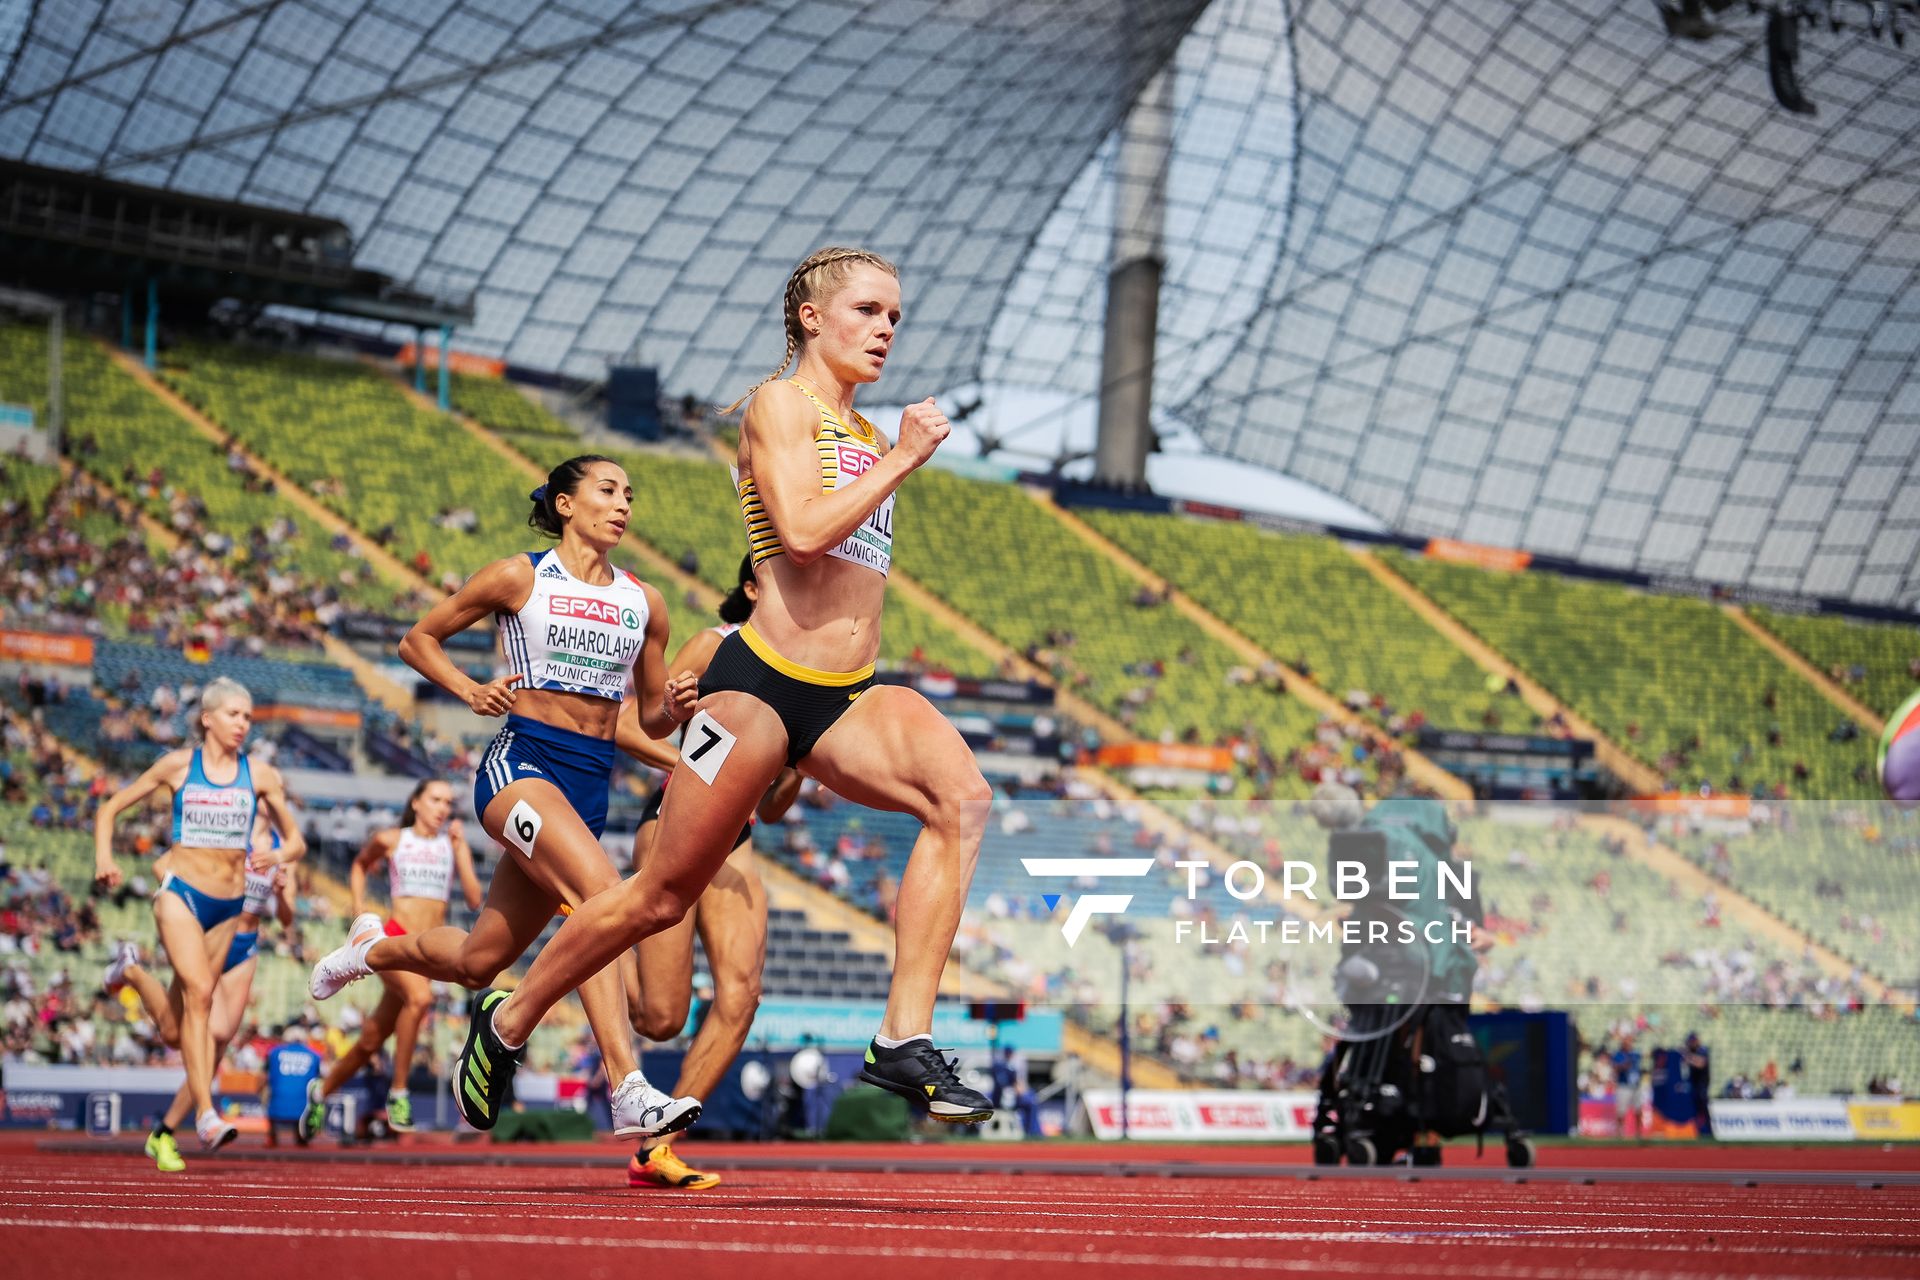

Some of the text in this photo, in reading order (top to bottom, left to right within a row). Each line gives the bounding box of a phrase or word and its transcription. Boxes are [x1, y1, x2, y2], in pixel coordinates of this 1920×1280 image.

[840, 449, 874, 475] SP
[870, 503, 892, 539] ILL
[839, 540, 878, 566] UNICH
[539, 572, 568, 582] adidas
[551, 597, 619, 624] SPAR
[546, 624, 640, 661] RAHAROLAHY
[545, 663, 622, 688] MUNICH 2022
[565, 654, 616, 671] I RUN CLEAN
[689, 724, 722, 762] 7
[184, 810, 247, 826] KUIVISTO
[514, 814, 535, 843] 6
